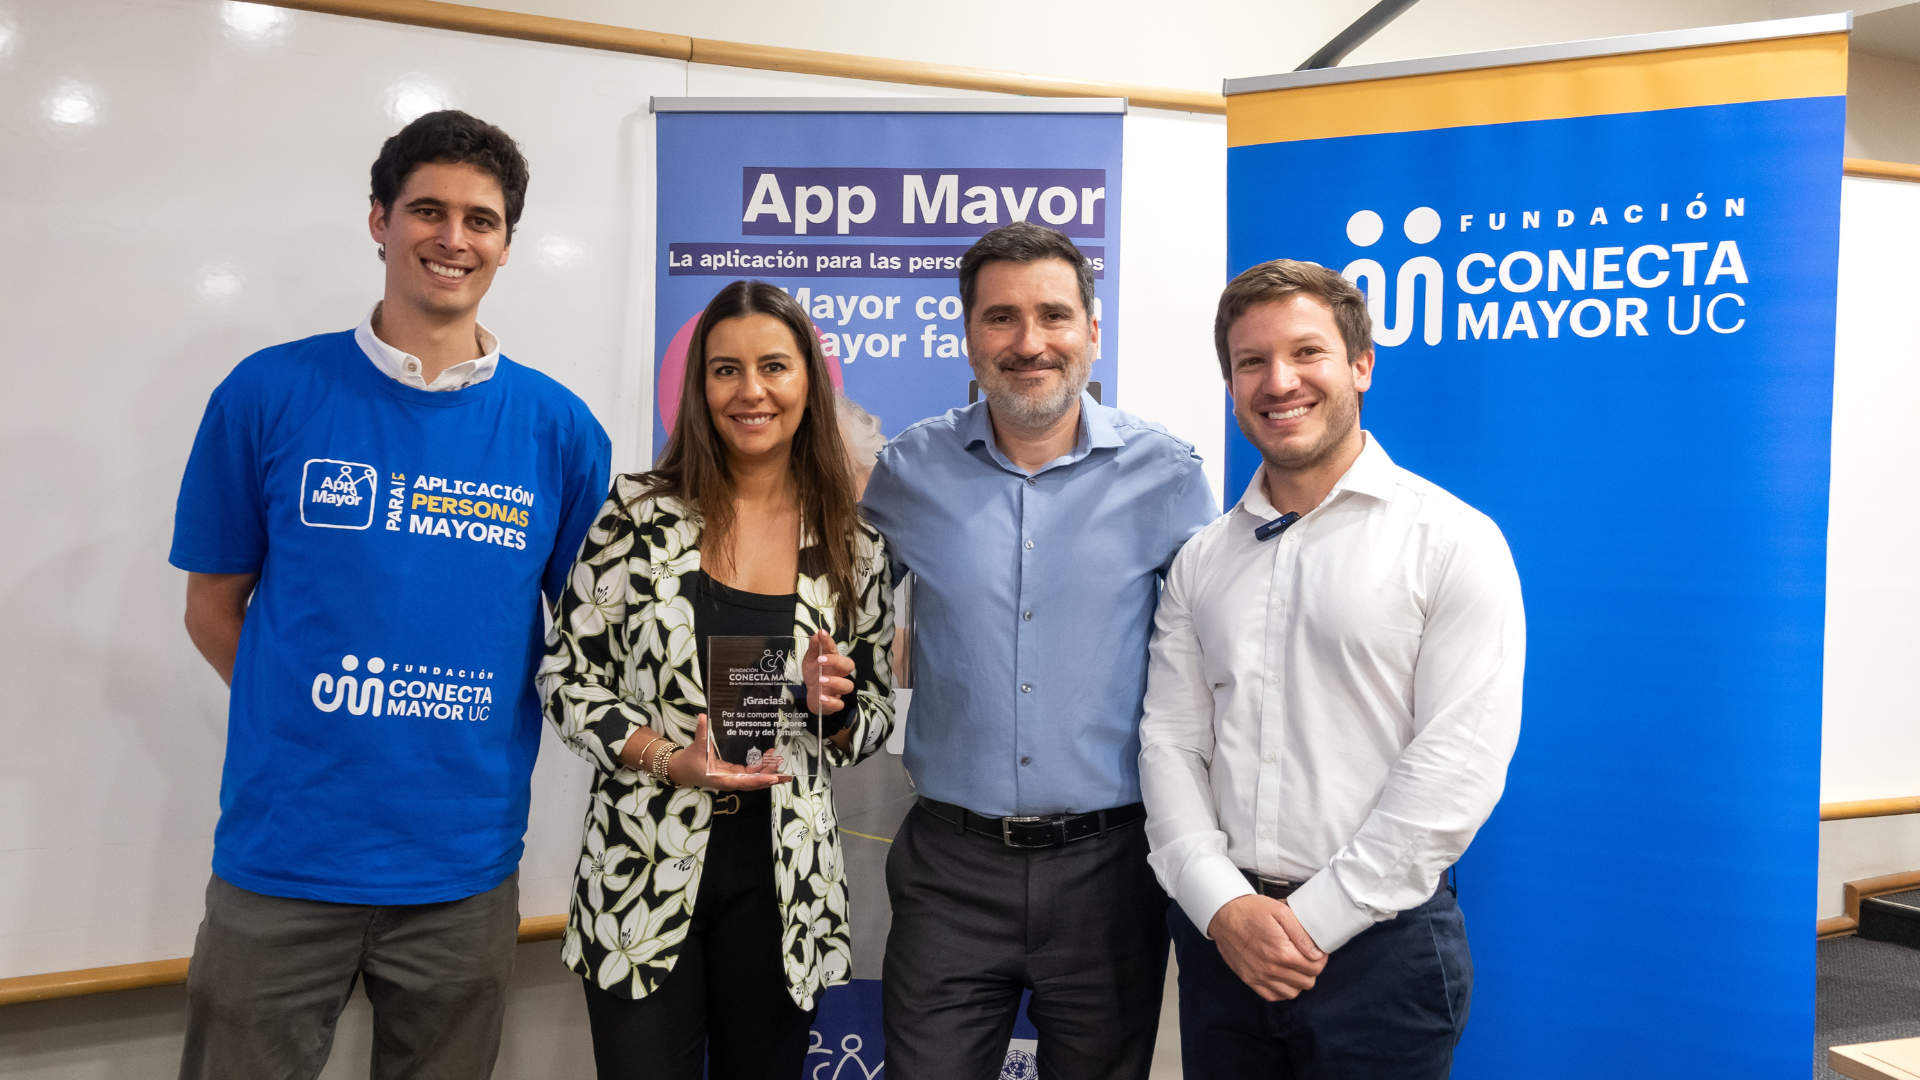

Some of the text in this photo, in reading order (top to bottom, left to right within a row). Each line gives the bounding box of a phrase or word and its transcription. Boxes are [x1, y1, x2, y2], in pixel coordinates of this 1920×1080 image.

[742, 173, 876, 234] App
[1460, 193, 1745, 233] FUNDACIÓN
[670, 249, 692, 268] La
[700, 249, 809, 272] aplicación
[816, 255, 865, 272] para
[869, 253, 901, 270] las
[1456, 240, 1749, 295] CONECTA
[1457, 293, 1746, 341] MAYOR UC
[813, 326, 907, 364] ayor
[312, 489, 363, 507] Mayor
[321, 476, 356, 494] App
[413, 474, 534, 507] APLICACIÓN
[386, 487, 406, 531] PARA
[411, 493, 529, 528] PERSONAS
[409, 514, 527, 550] MAYORES
[392, 663, 494, 680] FUNDACIÓN
[729, 673, 770, 681] CONECTA
[388, 679, 492, 704] CONECTA
[387, 699, 490, 722] MAYOR UC
[738, 729, 753, 737] hoy
